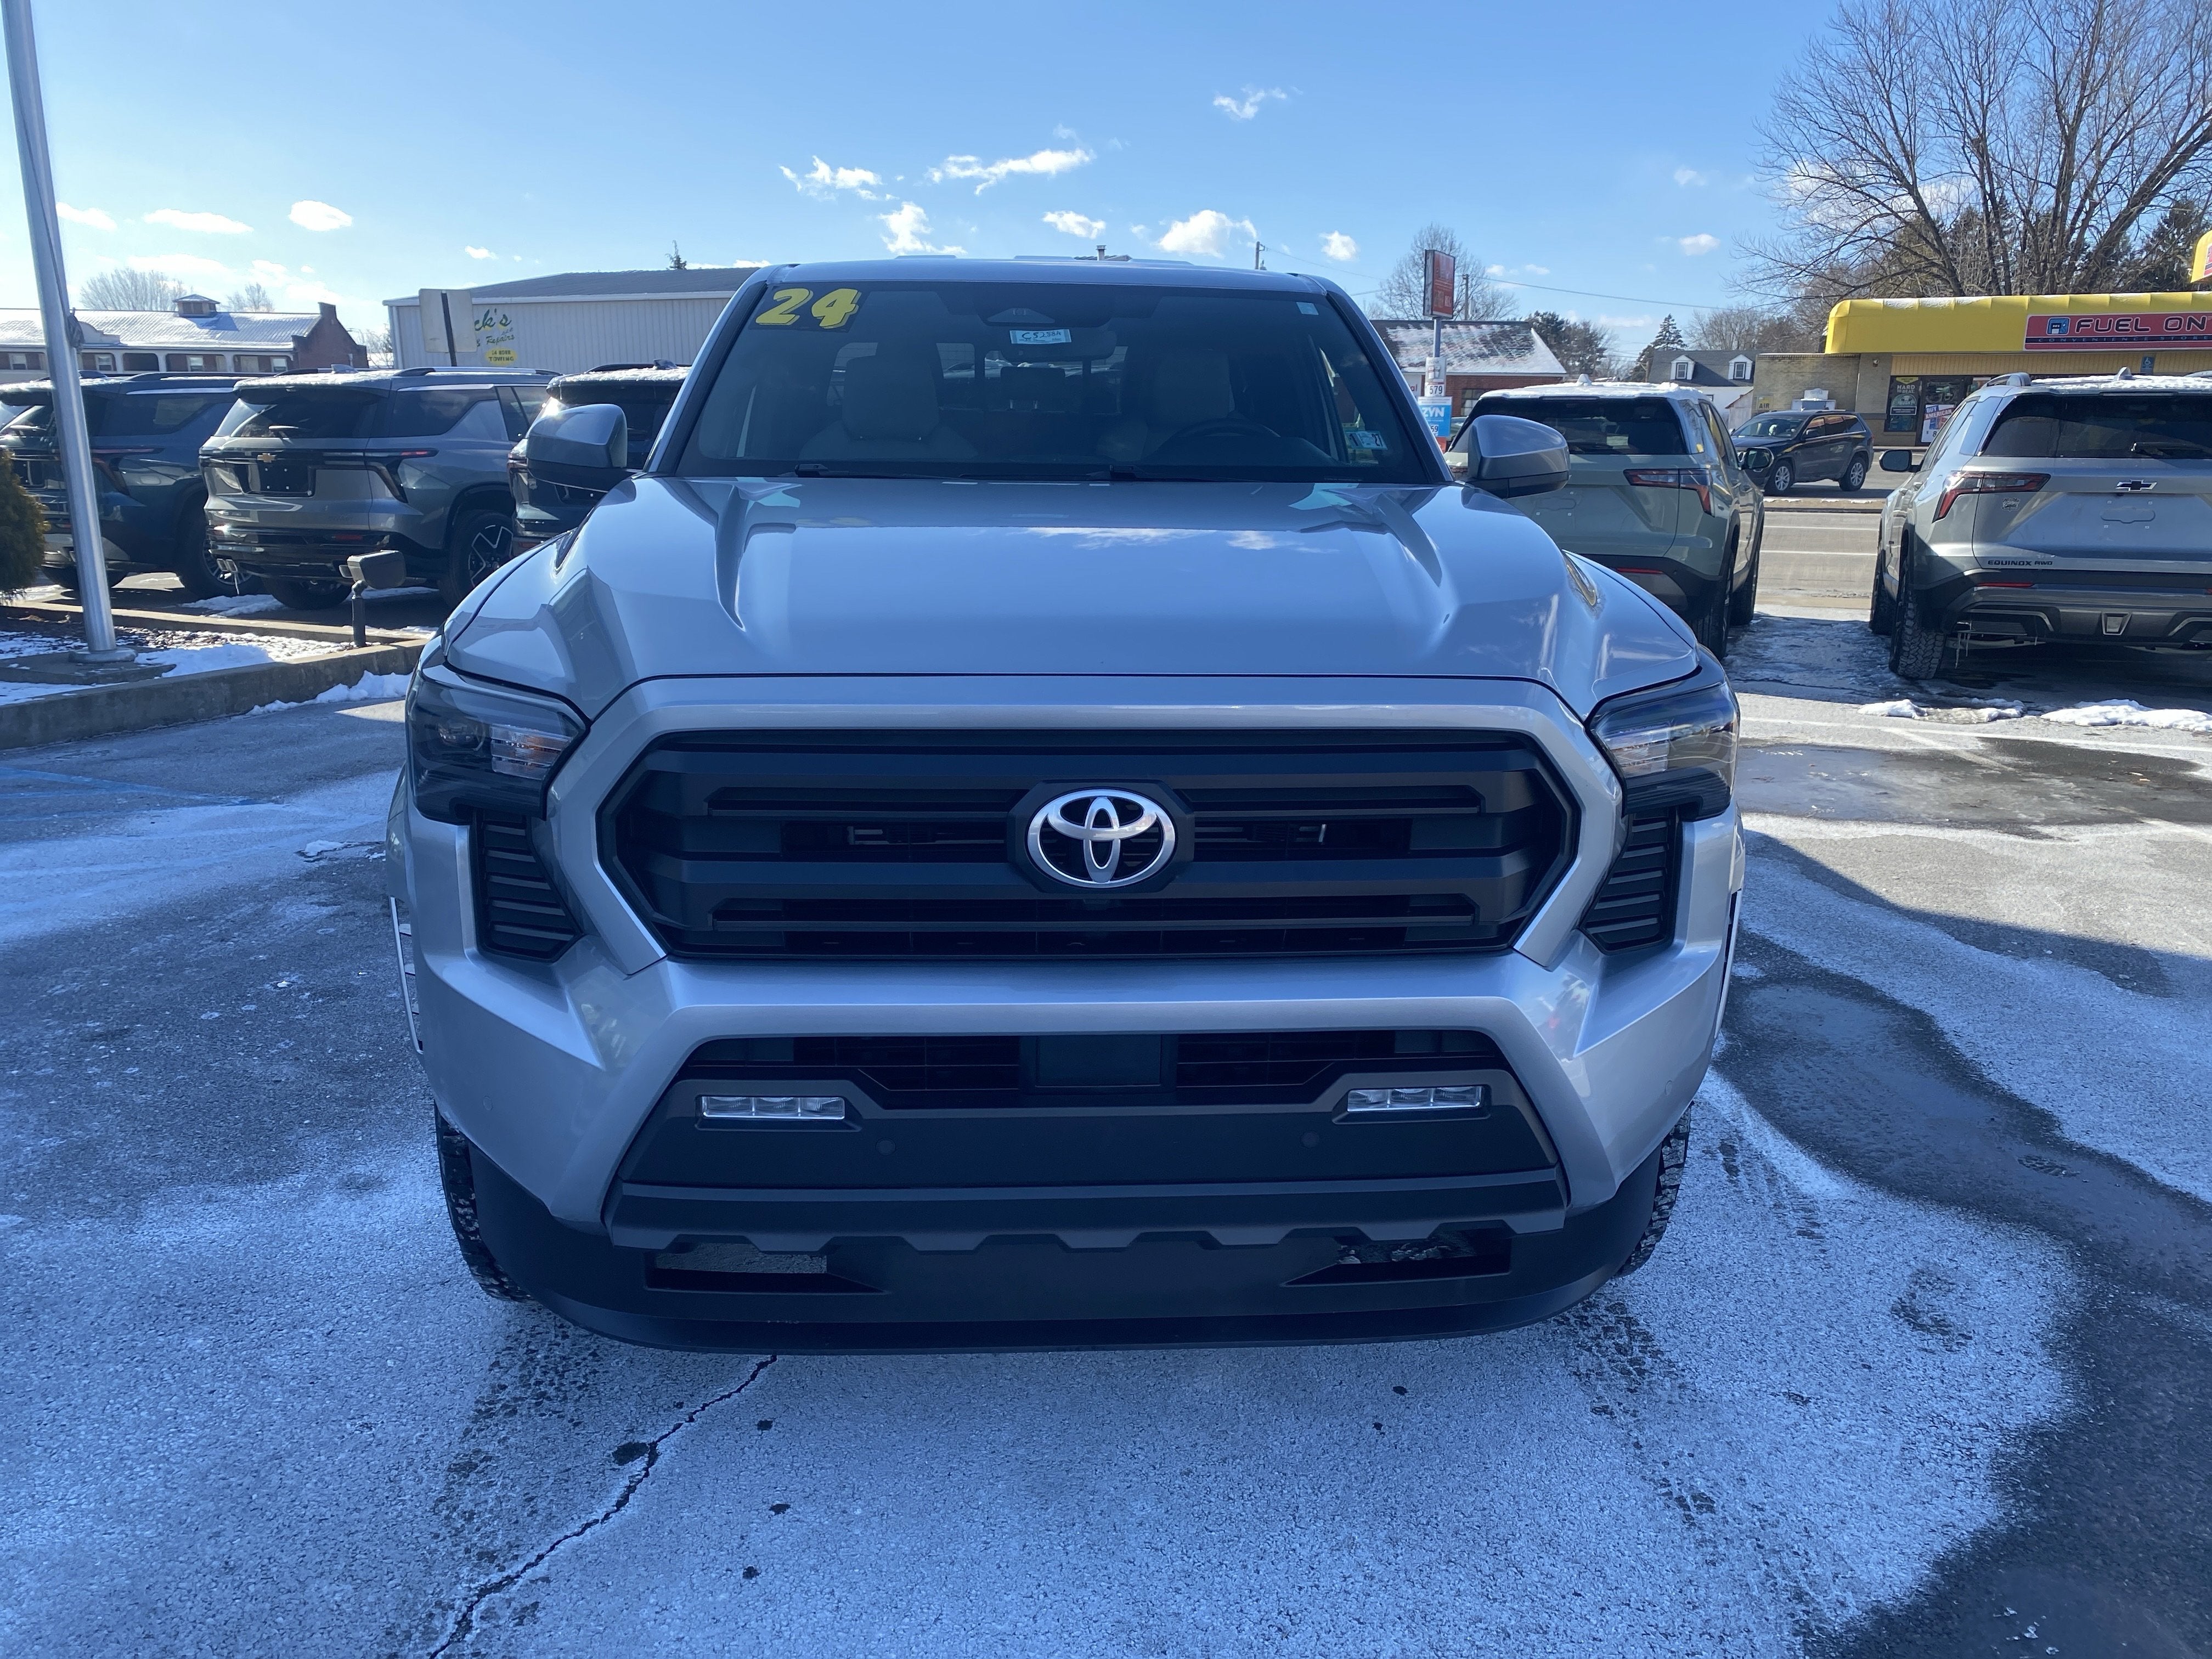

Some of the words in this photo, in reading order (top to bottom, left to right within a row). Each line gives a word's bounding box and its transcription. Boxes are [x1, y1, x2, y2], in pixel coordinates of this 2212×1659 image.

[755, 287, 862, 329] 24
[2075, 317, 2151, 334] FUEL
[2163, 315, 2207, 332] ON
[486, 334, 515, 346] Repairs
[1429, 385, 1443, 394] 579
[1421, 407, 1444, 417] ZYN
[1925, 409, 1952, 419] AMERICAN
